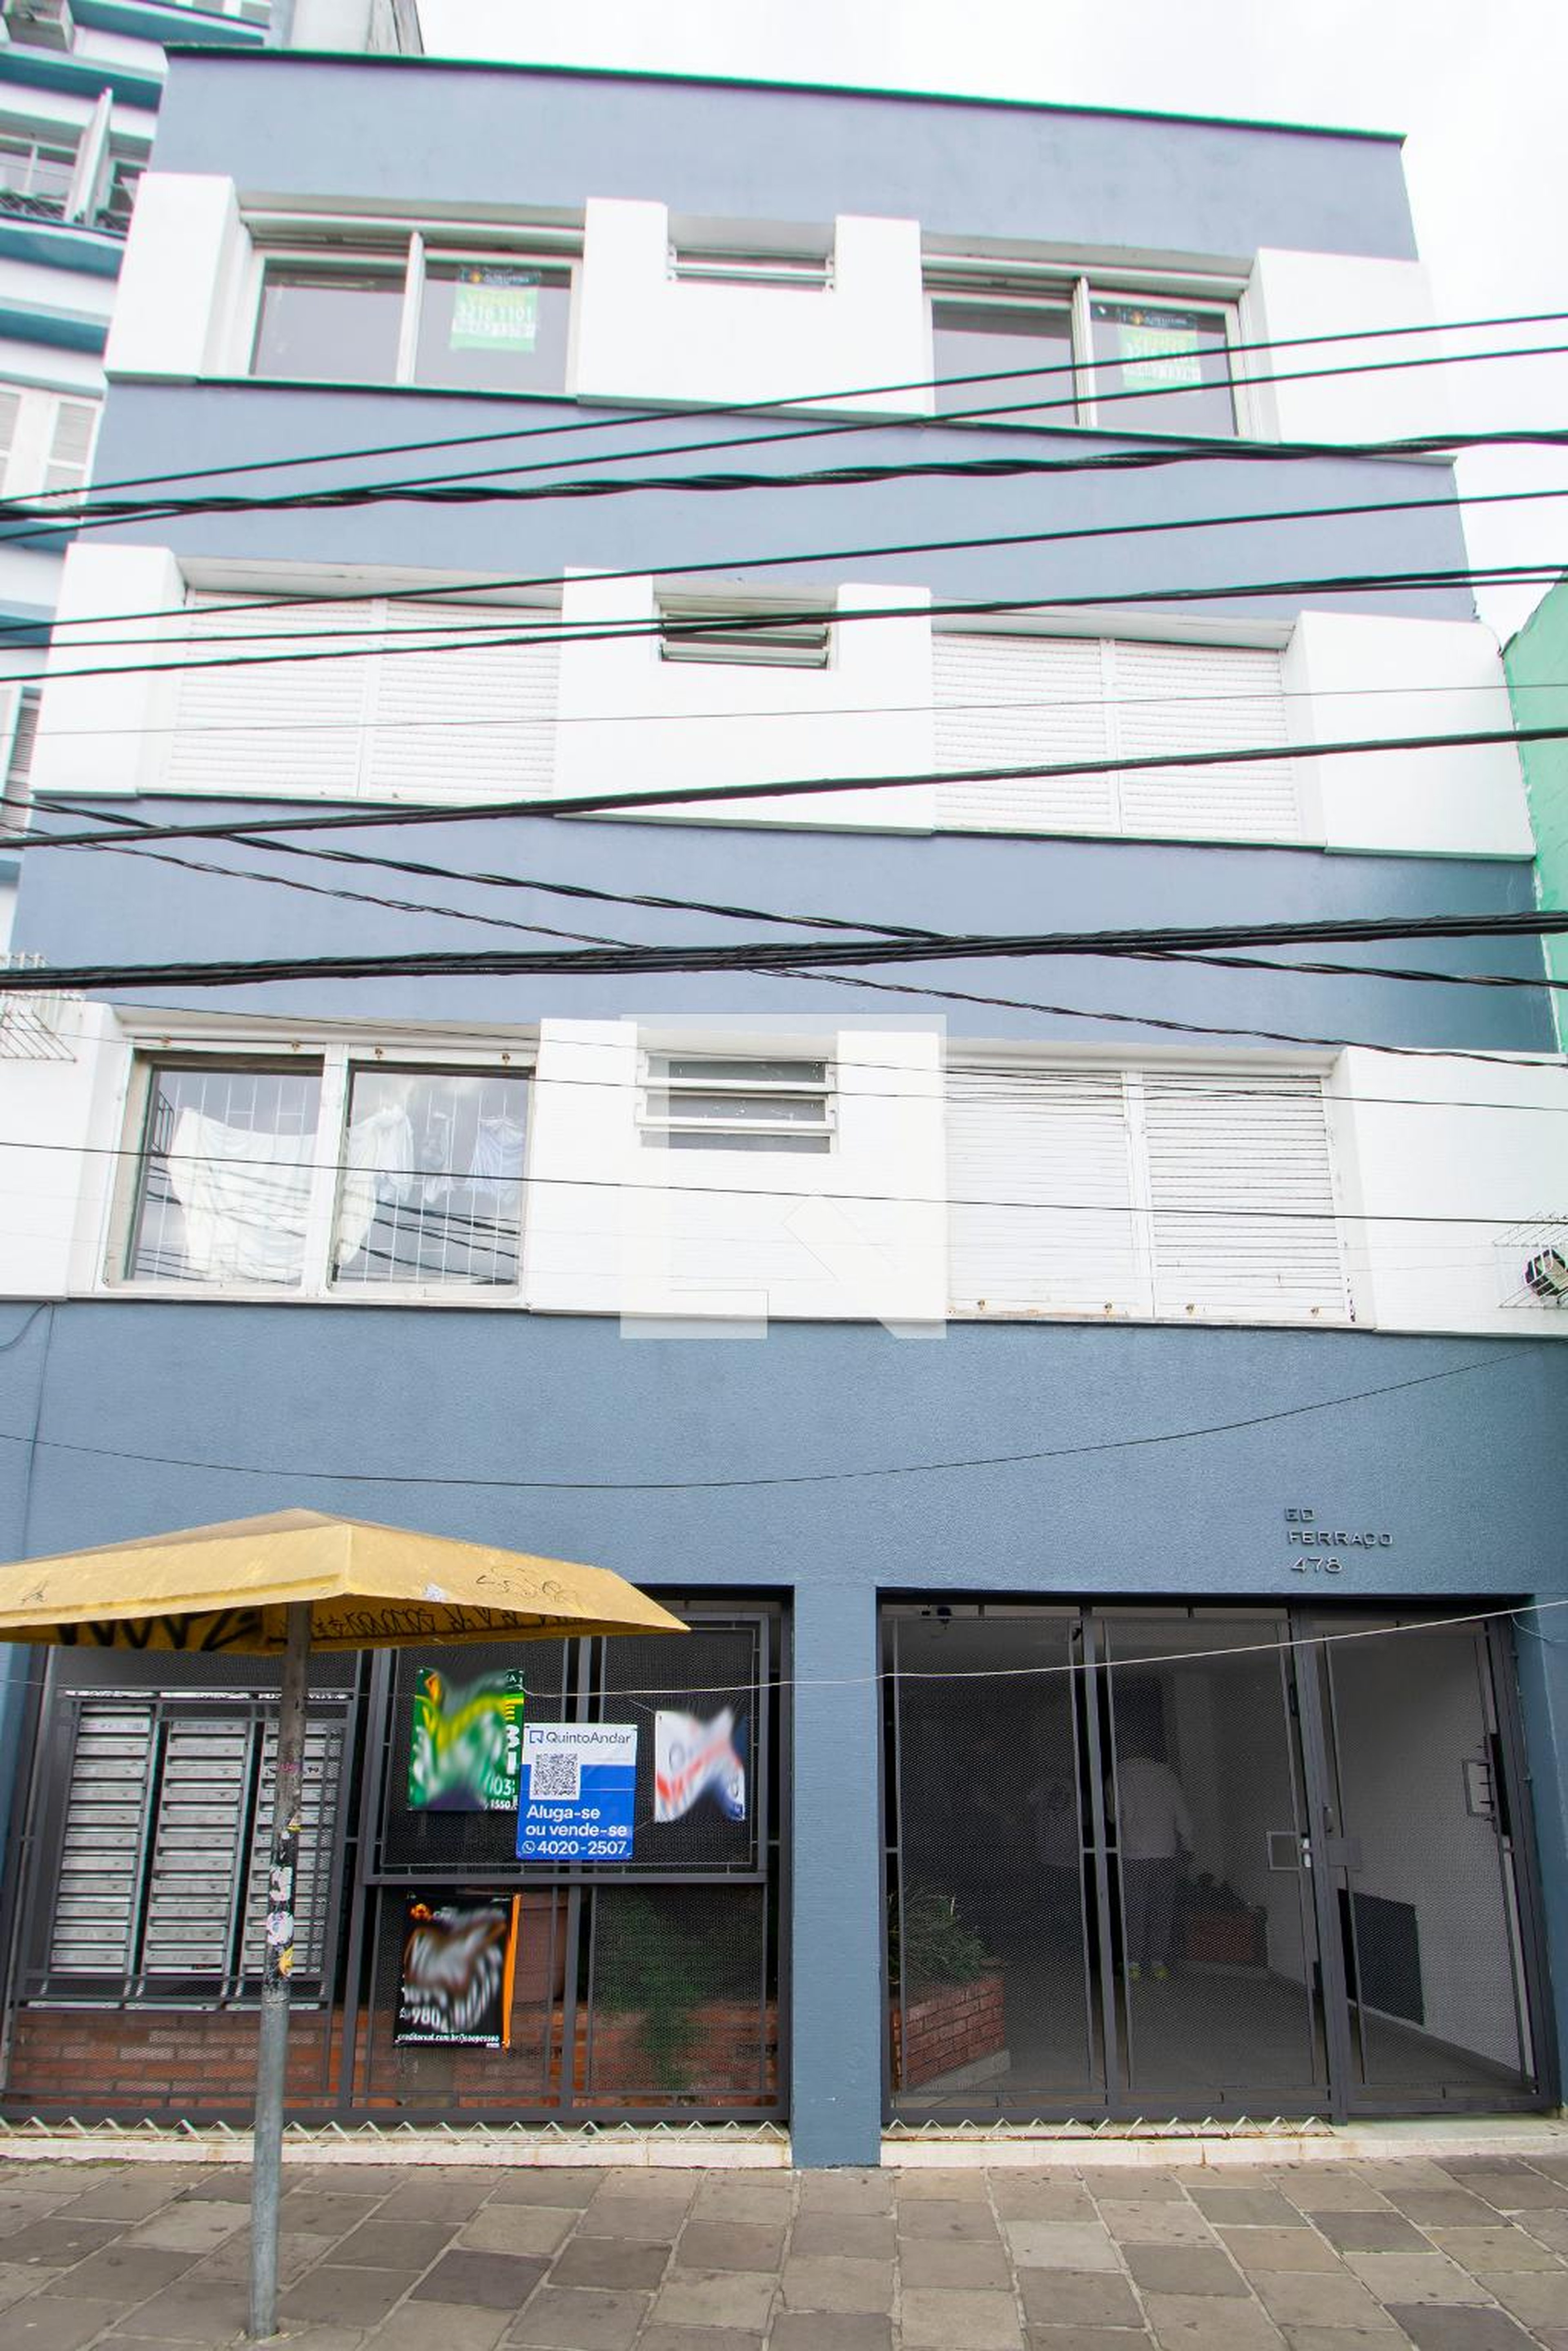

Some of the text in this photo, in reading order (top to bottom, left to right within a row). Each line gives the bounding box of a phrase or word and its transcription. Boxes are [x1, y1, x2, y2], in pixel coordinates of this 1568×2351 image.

[1287, 1530, 1393, 1549] FERRAÇO
[1290, 1557, 1343, 1574] 478
[546, 1731, 630, 1744] QuintoAndar
[527, 1805, 601, 1822] Aluga-se
[526, 1823, 627, 1836] ou vende-se
[537, 1840, 627, 1854] 4020-2507
